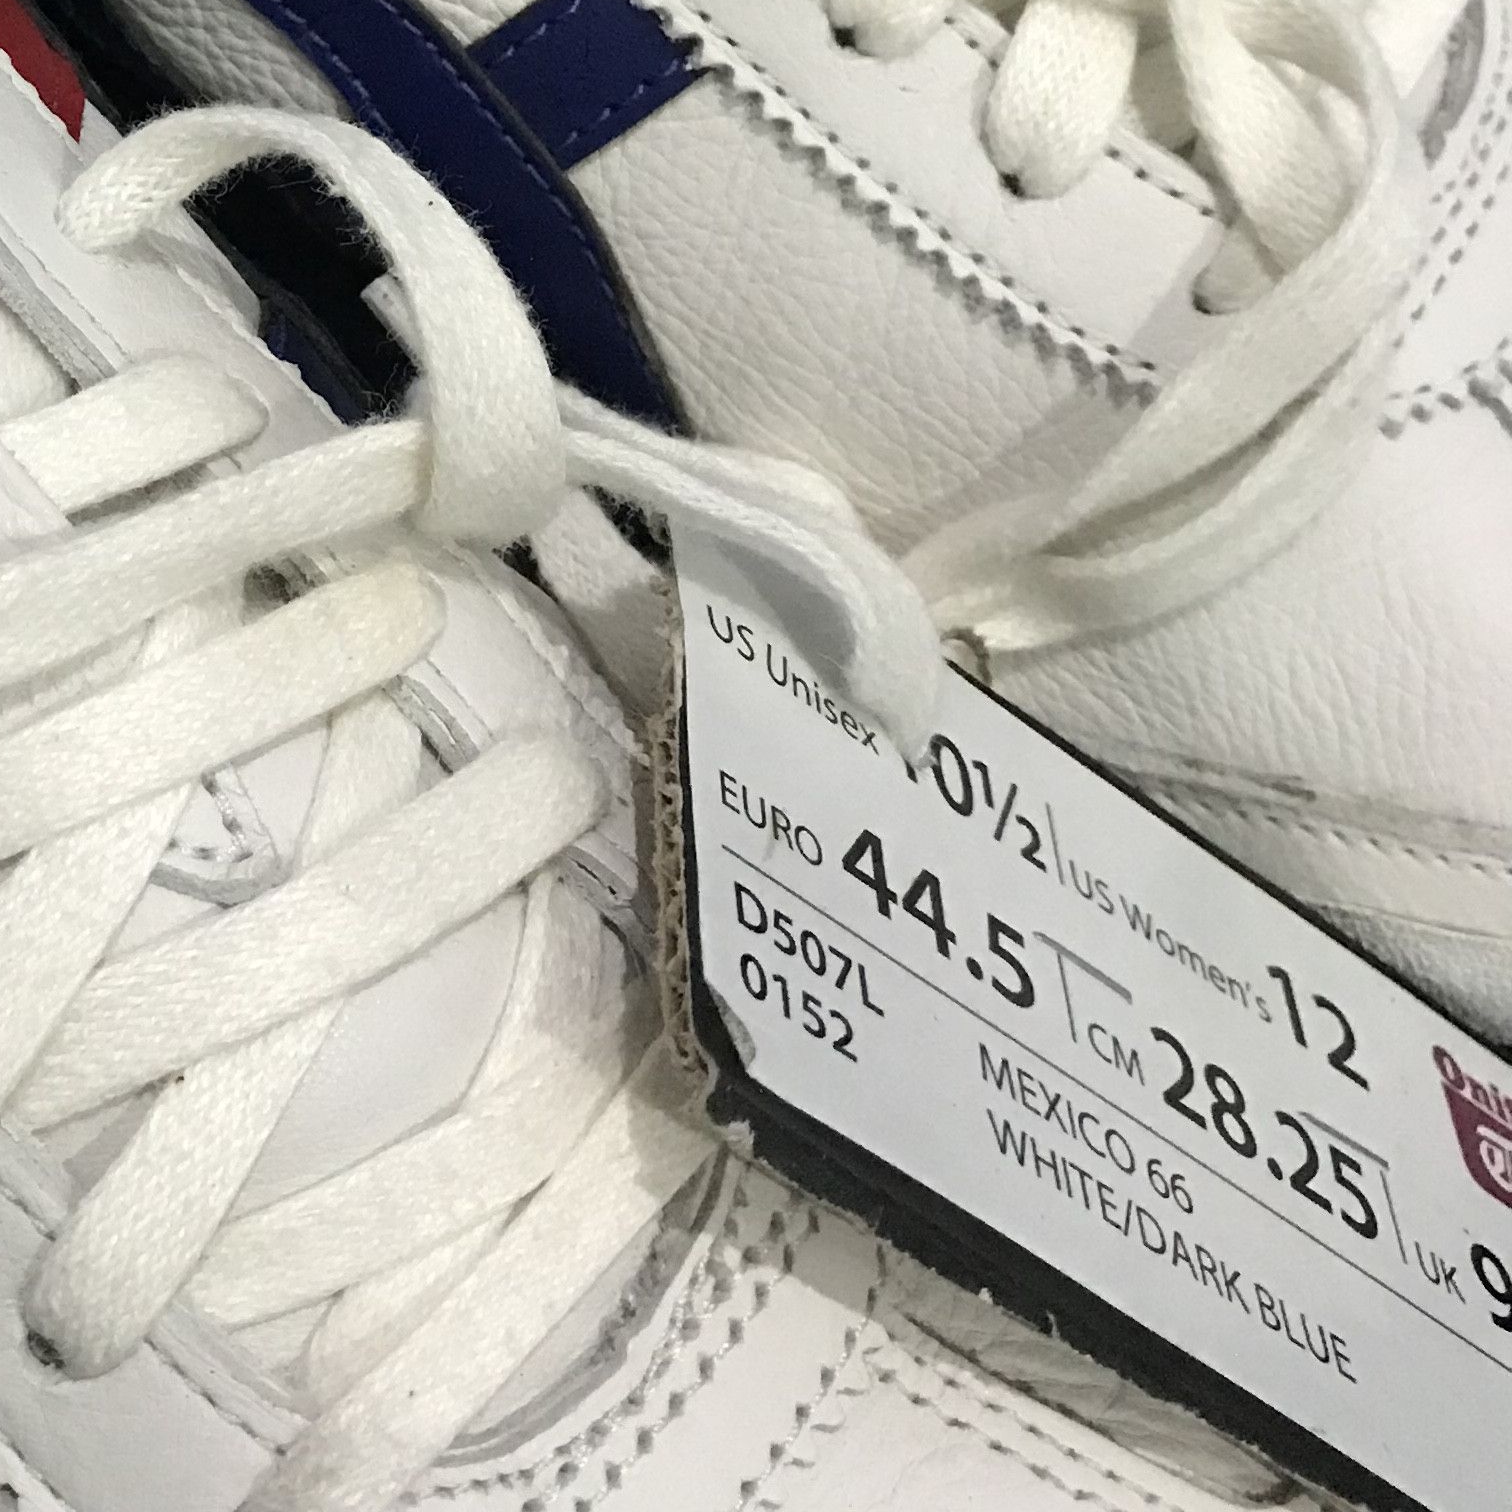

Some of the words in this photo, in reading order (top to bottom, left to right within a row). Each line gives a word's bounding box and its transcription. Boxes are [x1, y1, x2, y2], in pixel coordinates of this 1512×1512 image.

[706, 604, 755, 662] US
[766, 643, 880, 756] Unisex
[718, 769, 824, 867] EURO
[841, 828, 1036, 1009] 44.5
[734, 880, 885, 1018] D507L
[1068, 859, 1115, 916] US
[1119, 893, 1273, 1024] Women's
[1266, 964, 1370, 1092] 12
[739, 952, 859, 1064] 0152
[978, 1041, 1136, 1176] MEXICO
[1146, 1157, 1194, 1215] 66
[1087, 1022, 1146, 1087] CM
[1149, 1026, 1380, 1241] 28.25
[986, 1107, 1251, 1315] WHITE/DARK
[1253, 1282, 1358, 1385] BLUE
[1414, 1240, 1467, 1305] UK
